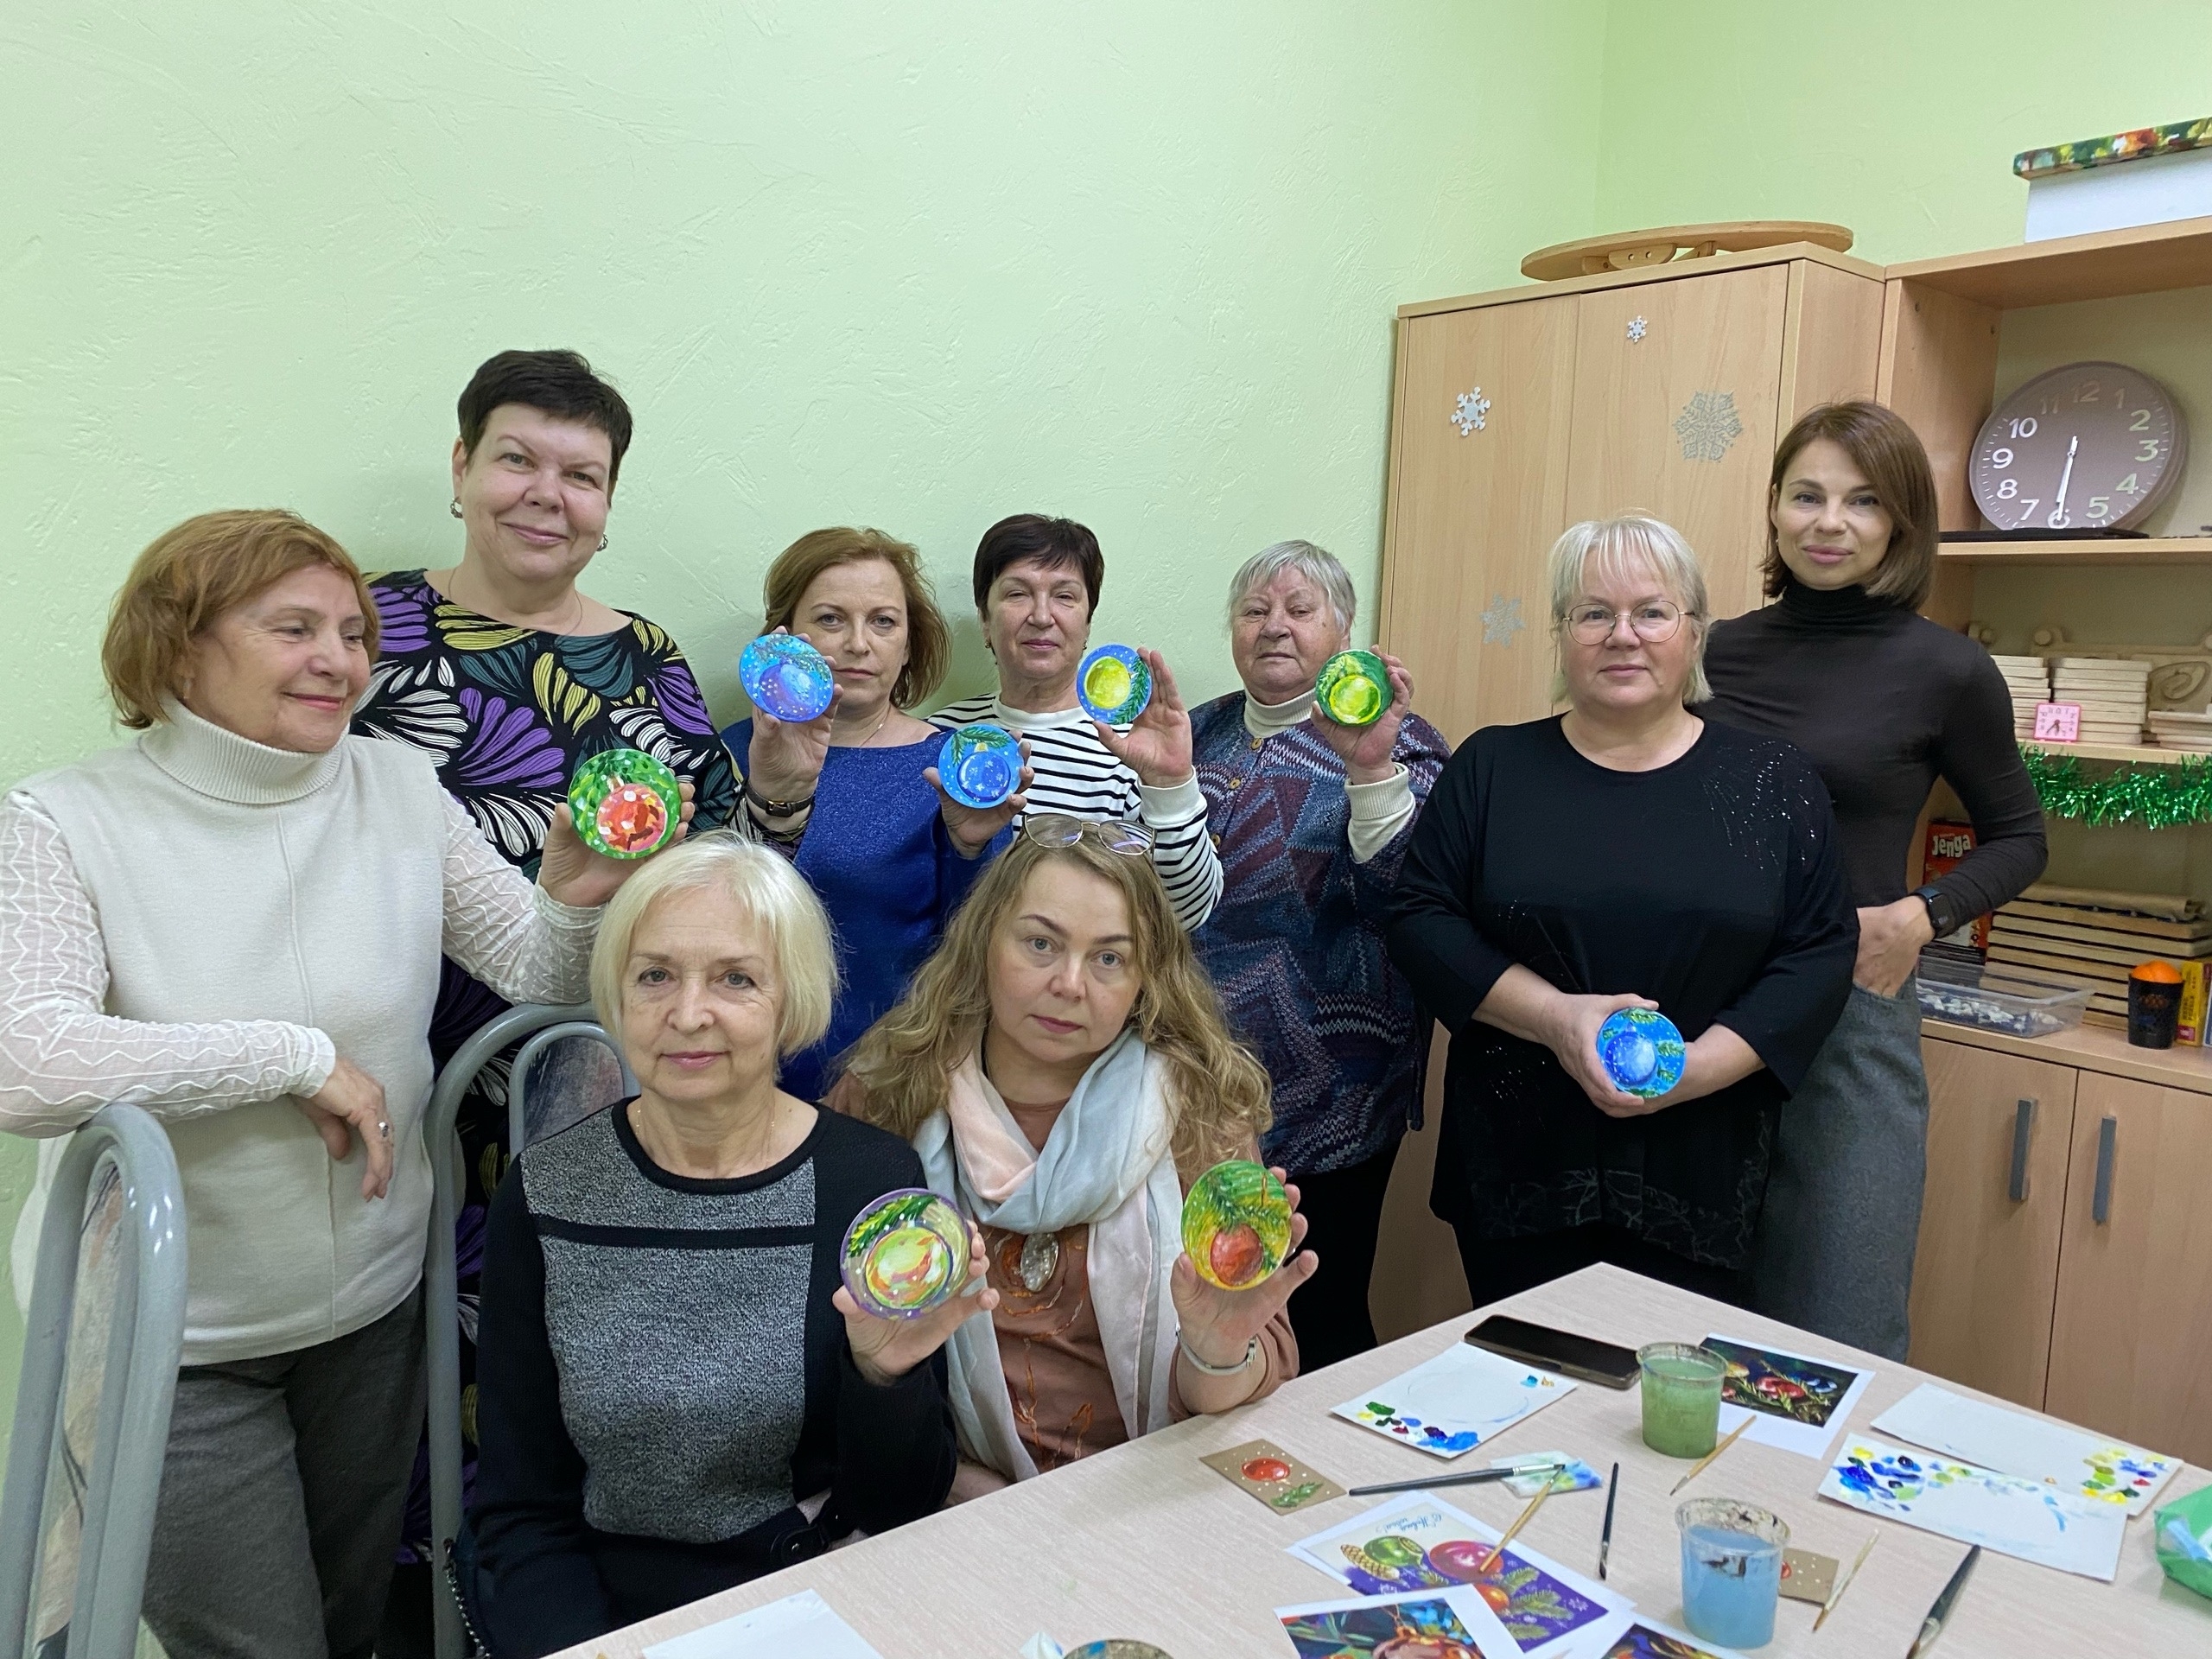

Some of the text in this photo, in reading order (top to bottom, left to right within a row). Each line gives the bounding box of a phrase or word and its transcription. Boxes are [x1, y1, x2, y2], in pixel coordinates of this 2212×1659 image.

[2073, 380, 2101, 404] 12
[2115, 388, 2126, 409] 1
[2009, 417, 2037, 438] 10
[2129, 410, 2151, 431] 2
[1992, 448, 2014, 469] 9
[2134, 439, 2158, 461] 3
[1997, 479, 2018, 499] 8
[2116, 473, 2139, 494] 4
[2020, 499, 2039, 520] 7
[2086, 496, 2109, 518] 5
[2047, 508, 2070, 529] 6
[1932, 835, 1971, 858] Jenga
